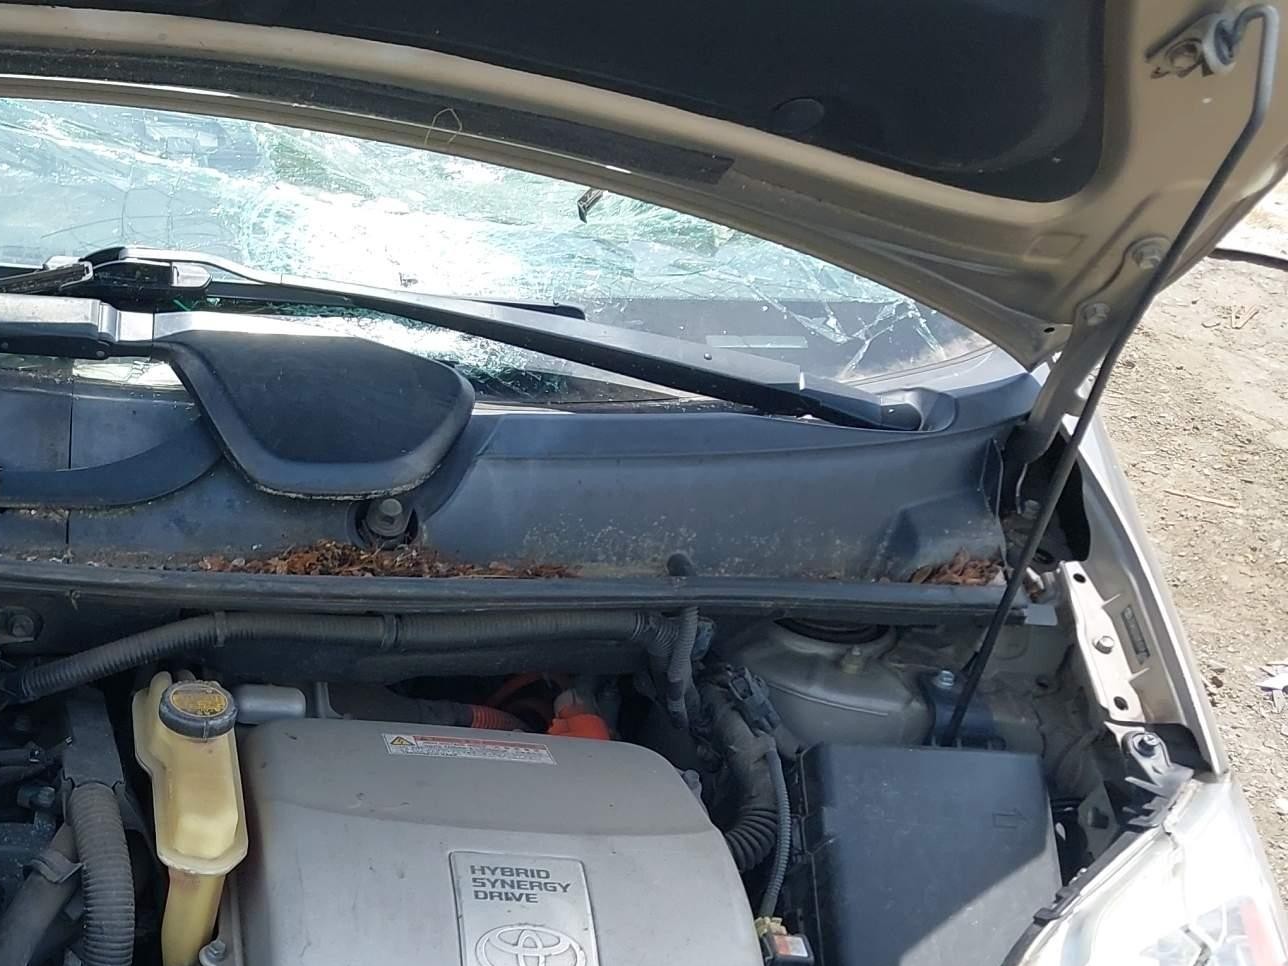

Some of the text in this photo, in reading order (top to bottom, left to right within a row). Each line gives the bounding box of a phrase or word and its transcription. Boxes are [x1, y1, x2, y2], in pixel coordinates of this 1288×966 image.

[470, 865, 550, 879] HYBRID
[472, 877, 571, 893] SYNERGY
[474, 890, 538, 903] DRIVE
